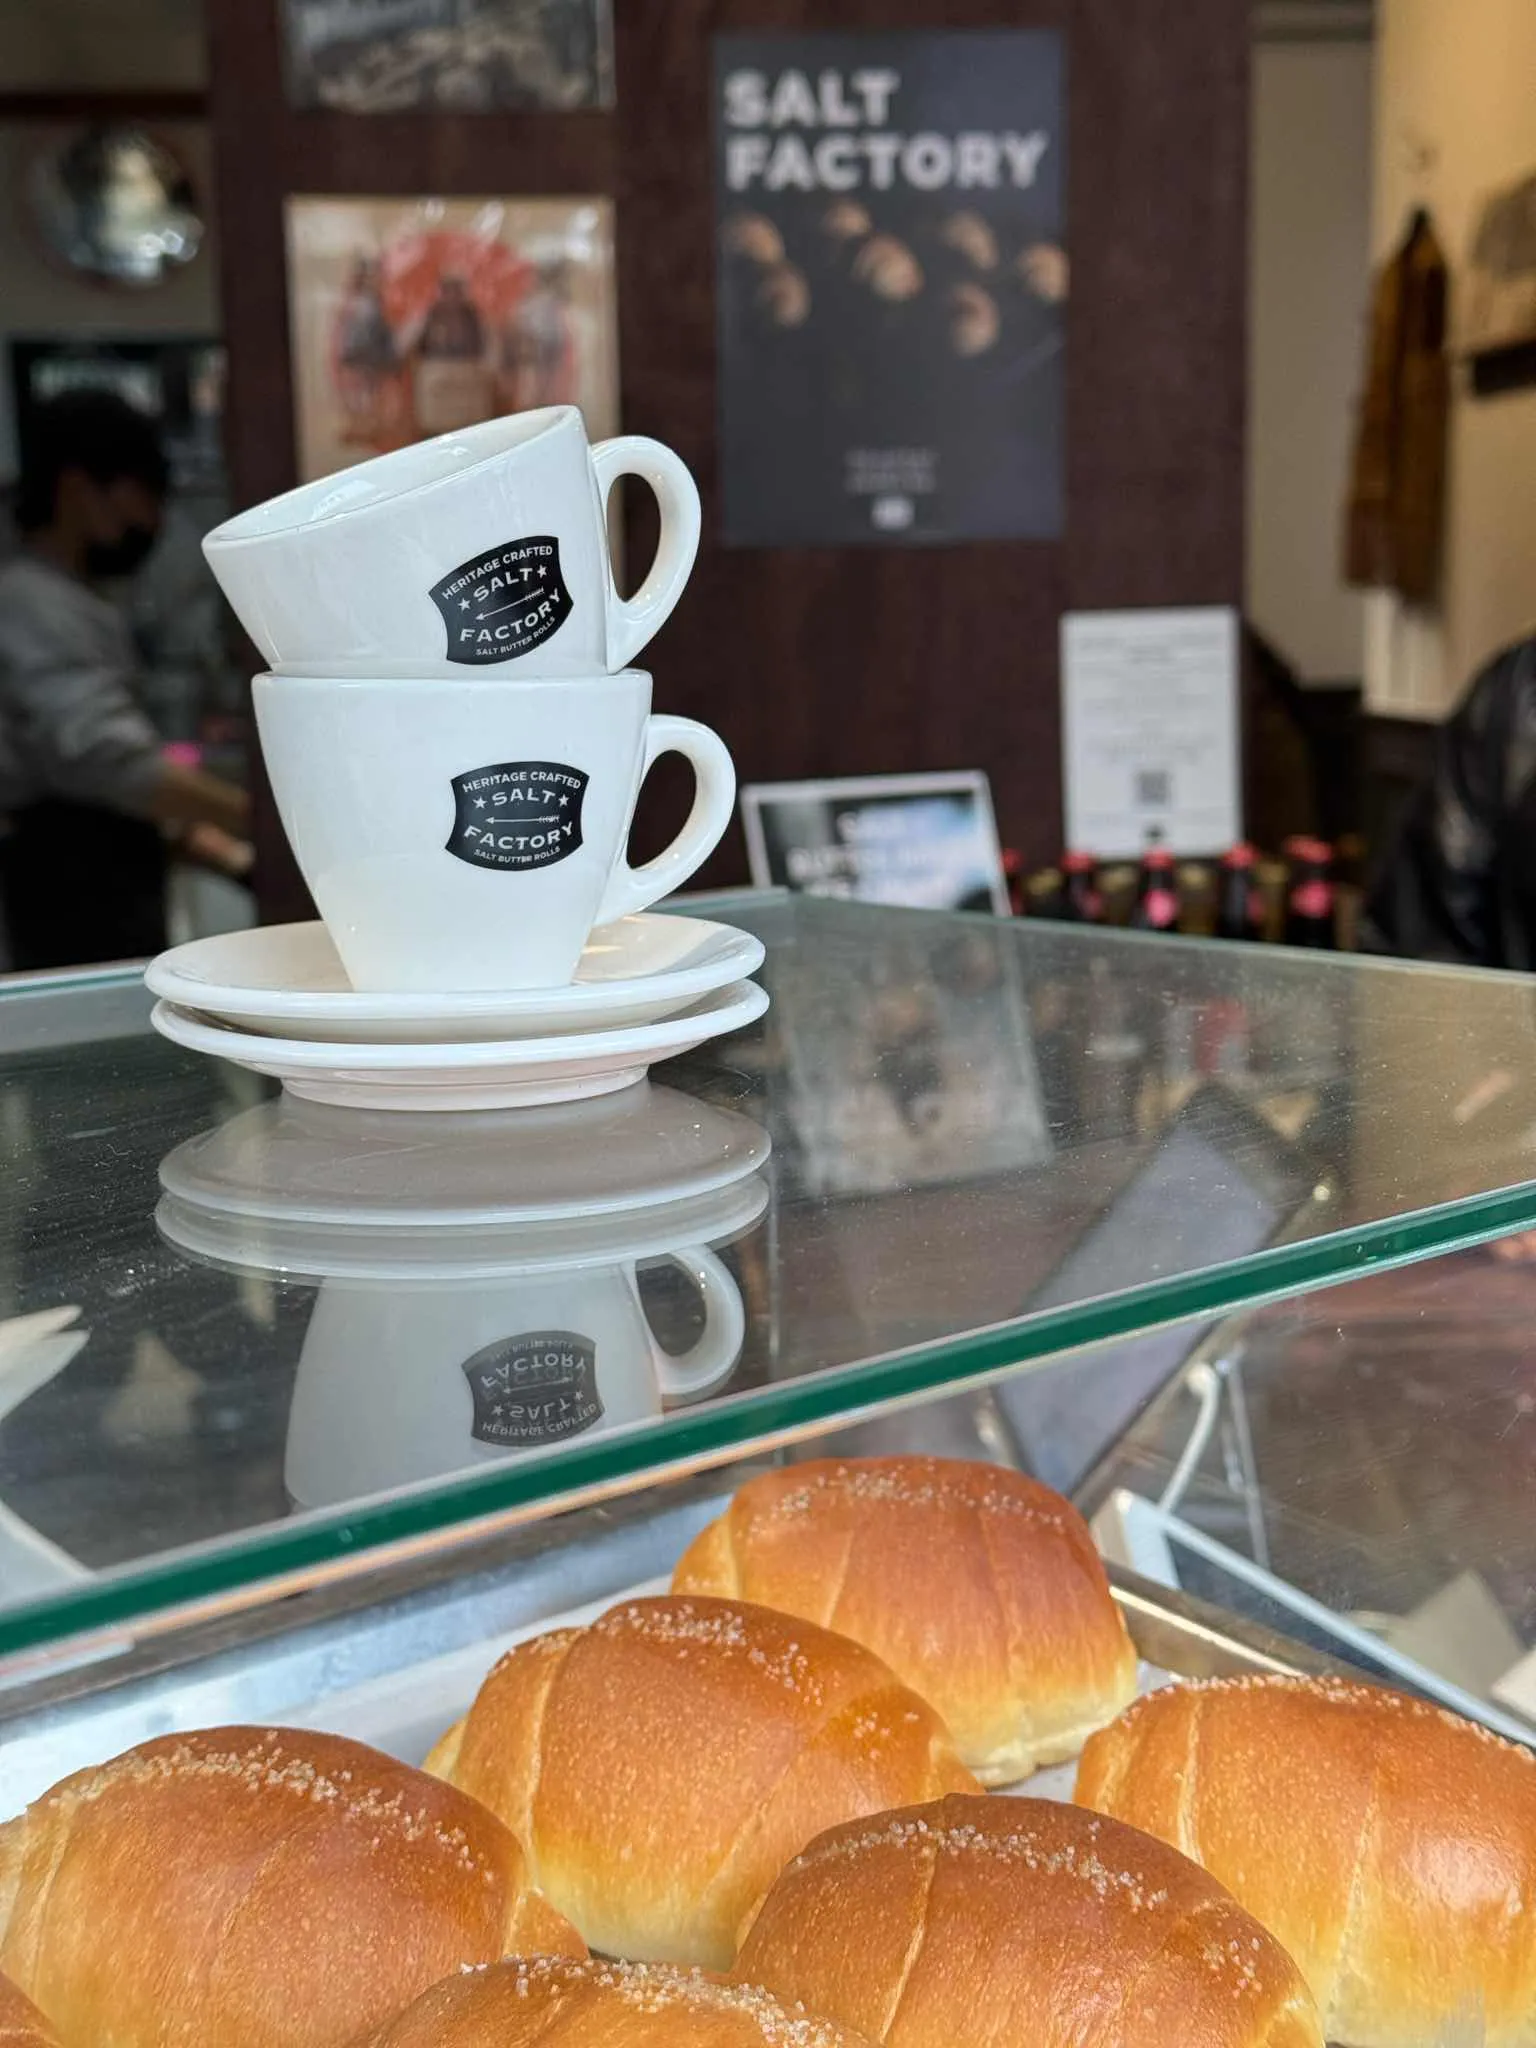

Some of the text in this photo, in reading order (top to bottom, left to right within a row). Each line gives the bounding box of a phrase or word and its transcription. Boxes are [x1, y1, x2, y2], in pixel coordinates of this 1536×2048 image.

[724, 67, 899, 128] SALT
[725, 130, 1048, 192] FACTORY
[441, 546, 553, 600] HERITAGE CRAFTED
[473, 568, 533, 601] SALT
[460, 588, 561, 642] FACTORY
[476, 616, 556, 656] SALT BUTTER ROLLS
[462, 771, 582, 793] HERITAGE CRAFTED
[491, 787, 556, 806] SALT
[463, 821, 573, 850] FACTORY
[473, 848, 497, 861] SALT
[534, 846, 561, 861] ROLLS
